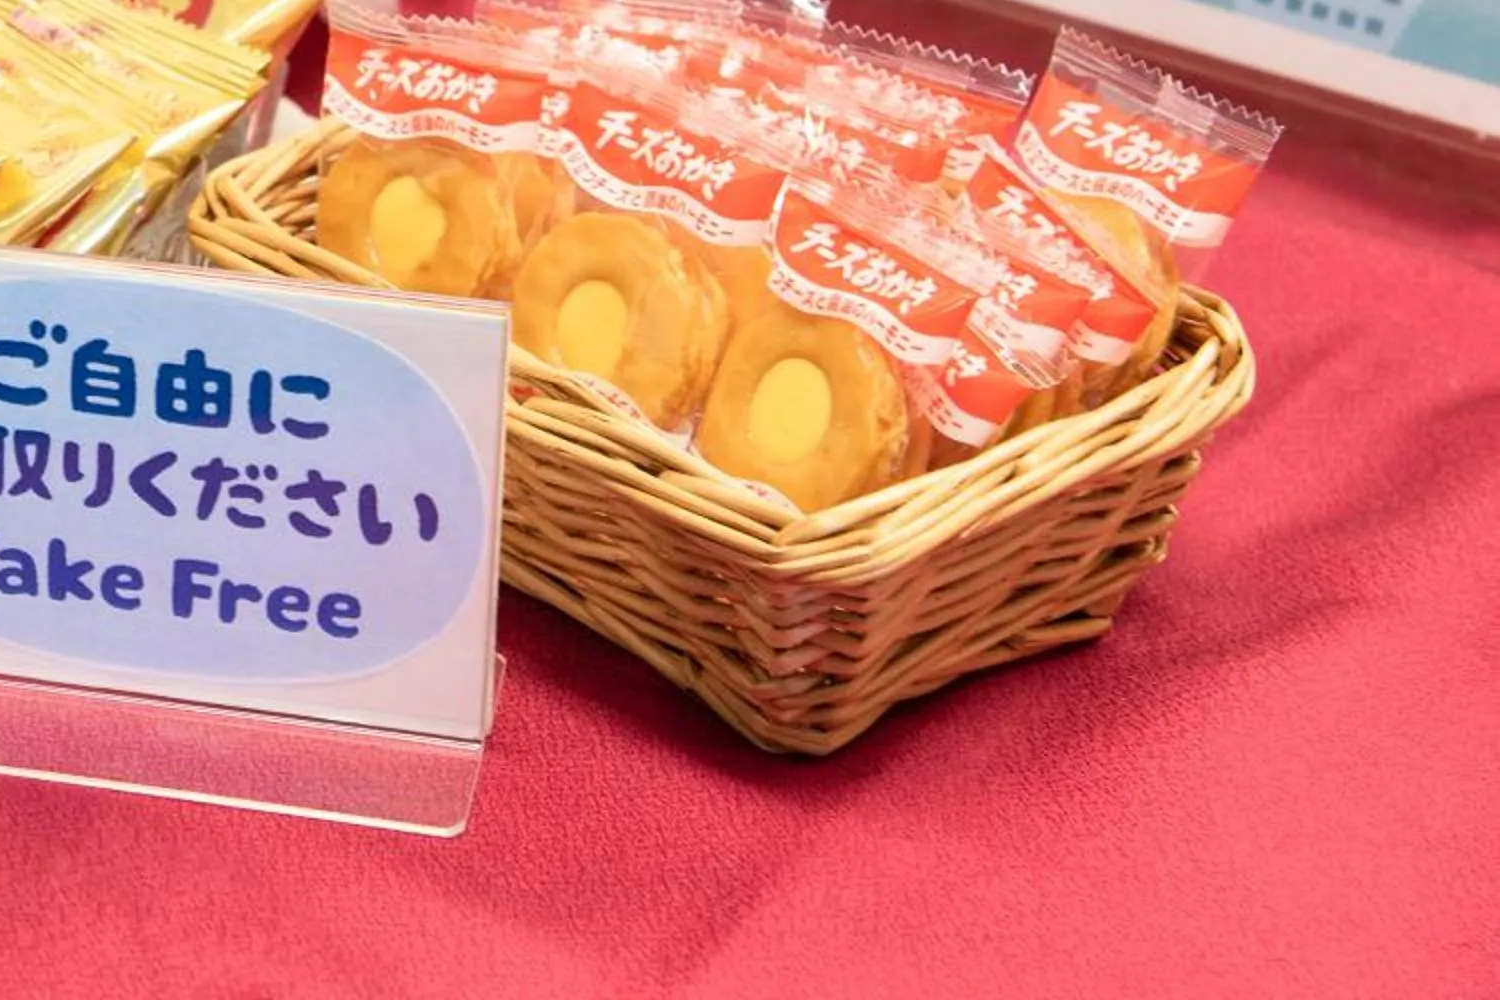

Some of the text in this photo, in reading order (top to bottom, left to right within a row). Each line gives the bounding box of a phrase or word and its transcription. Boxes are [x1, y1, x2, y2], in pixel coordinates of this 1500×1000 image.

[355, 47, 498, 114] チーズおかき
[596, 109, 737, 201] チーズおかき
[1050, 98, 1203, 192] チーズおかき
[790, 222, 939, 313] チーズおかき
[170, 557, 364, 640] Free
